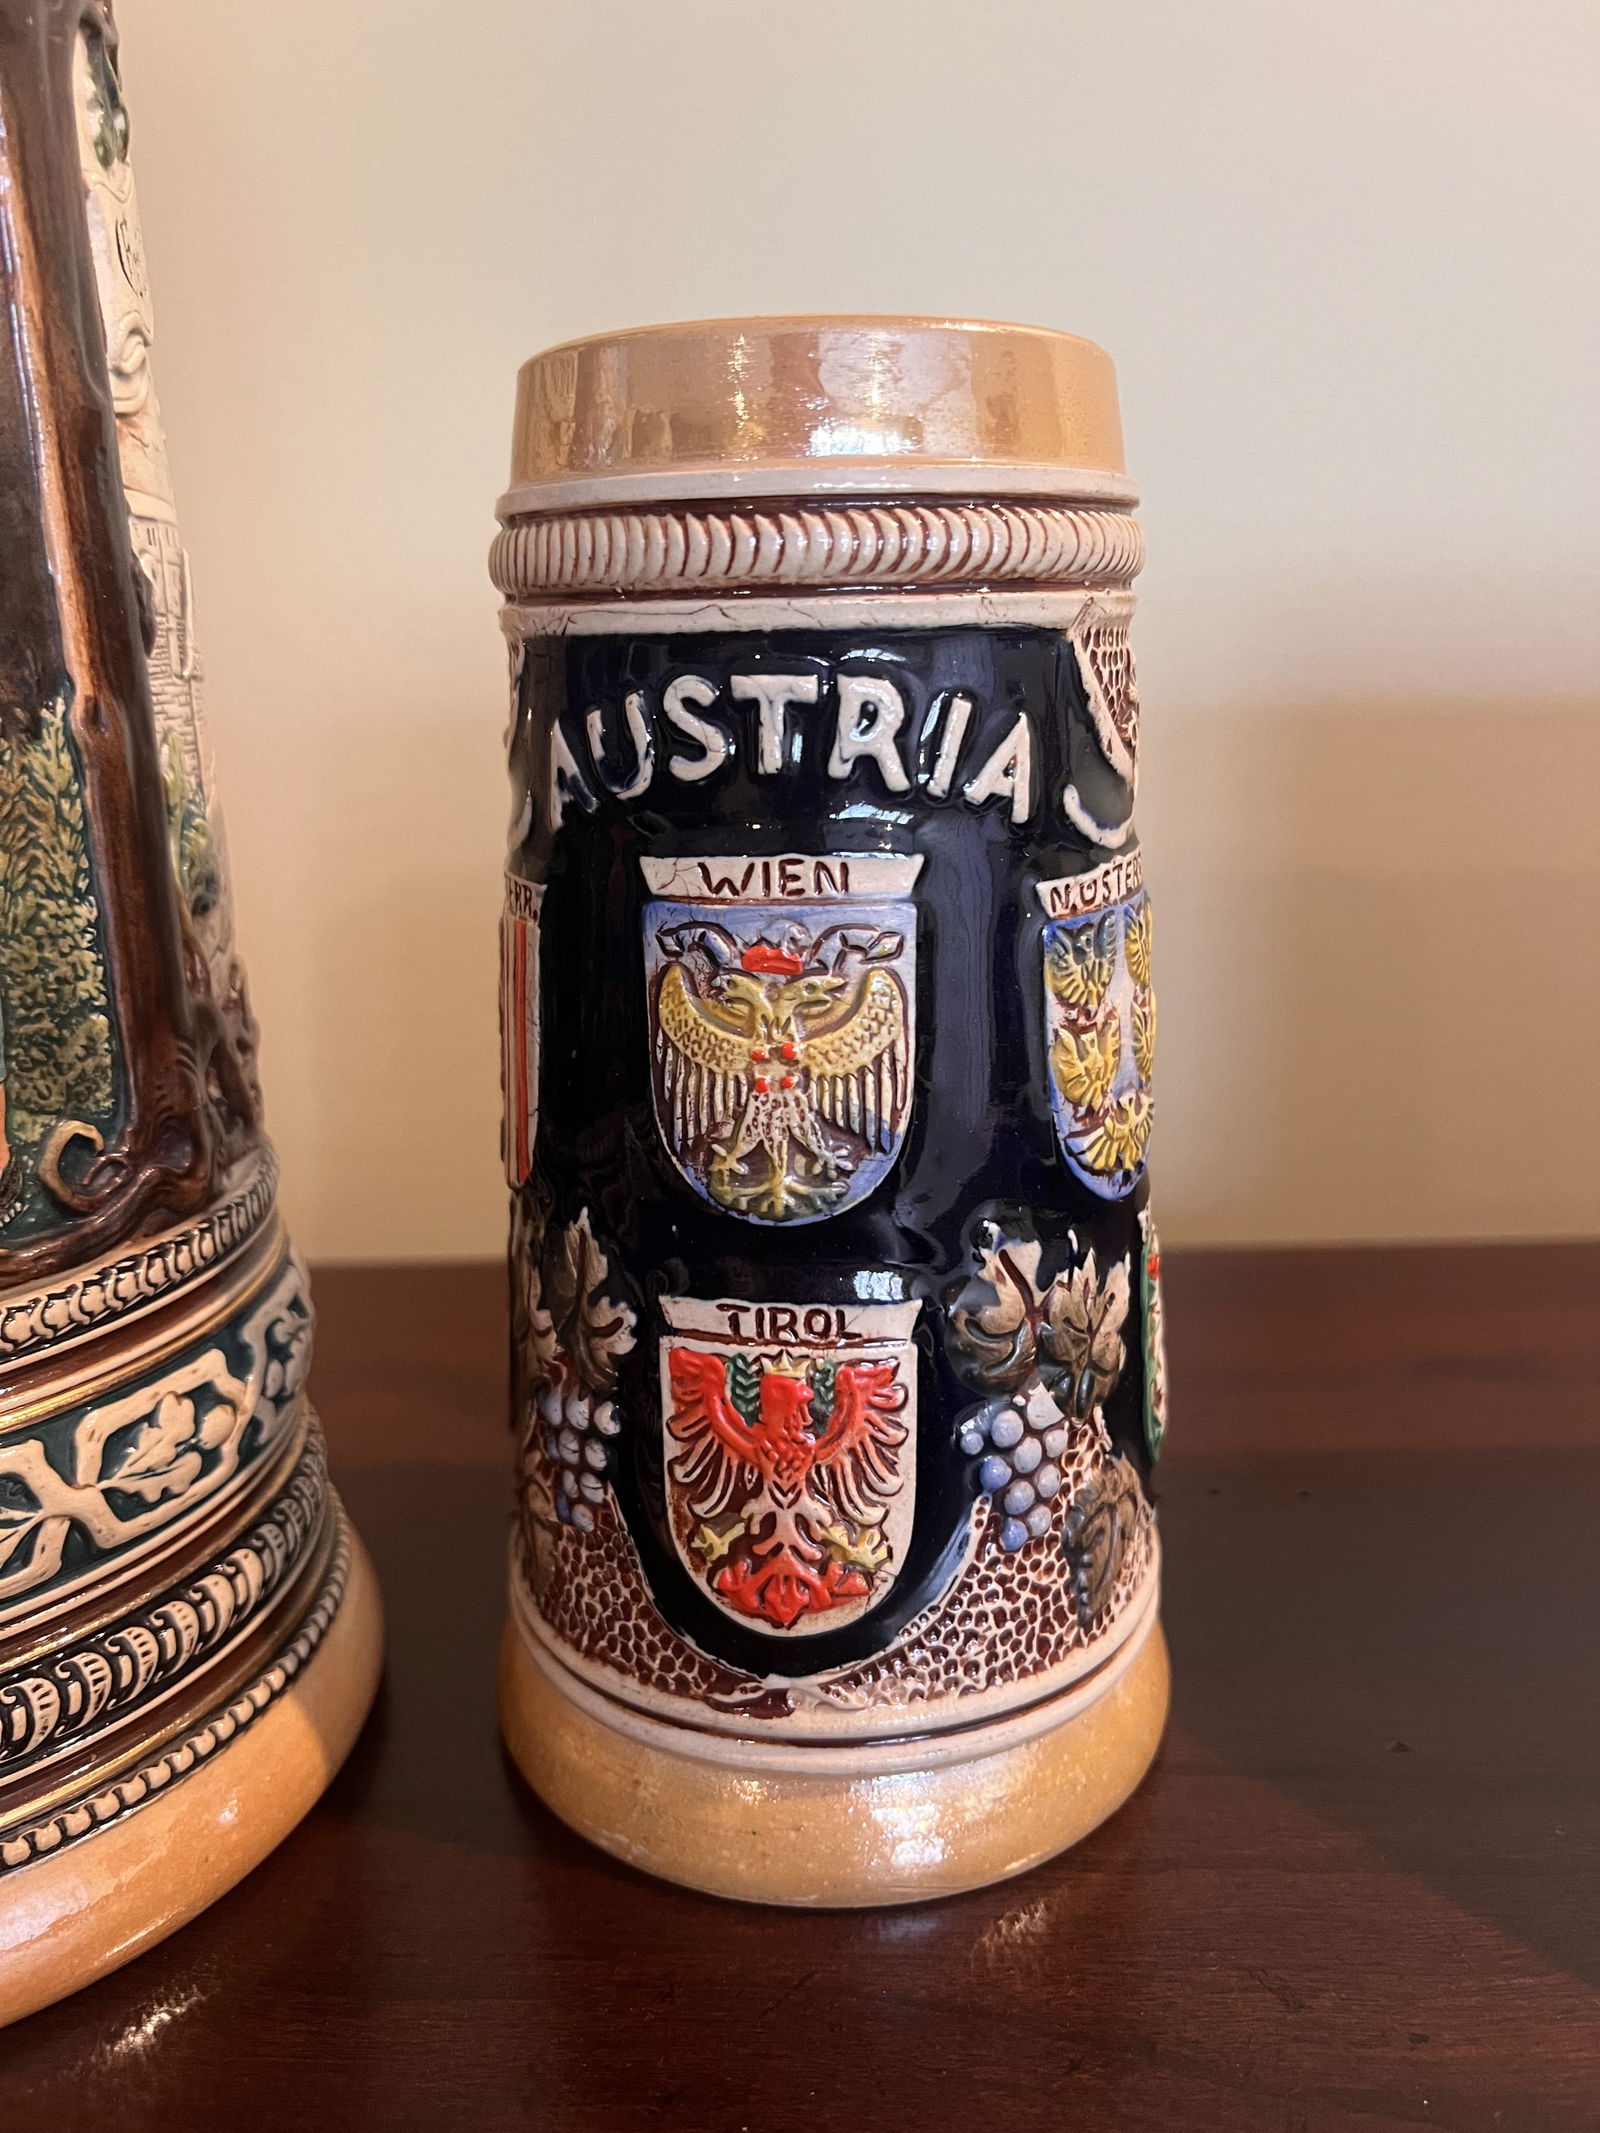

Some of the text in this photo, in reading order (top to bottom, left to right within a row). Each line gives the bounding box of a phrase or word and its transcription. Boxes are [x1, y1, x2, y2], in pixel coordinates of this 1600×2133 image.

[549, 673, 1030, 834] AUSTRIA
[697, 857, 850, 898] WIEN
[715, 1302, 863, 1342] TIROL
